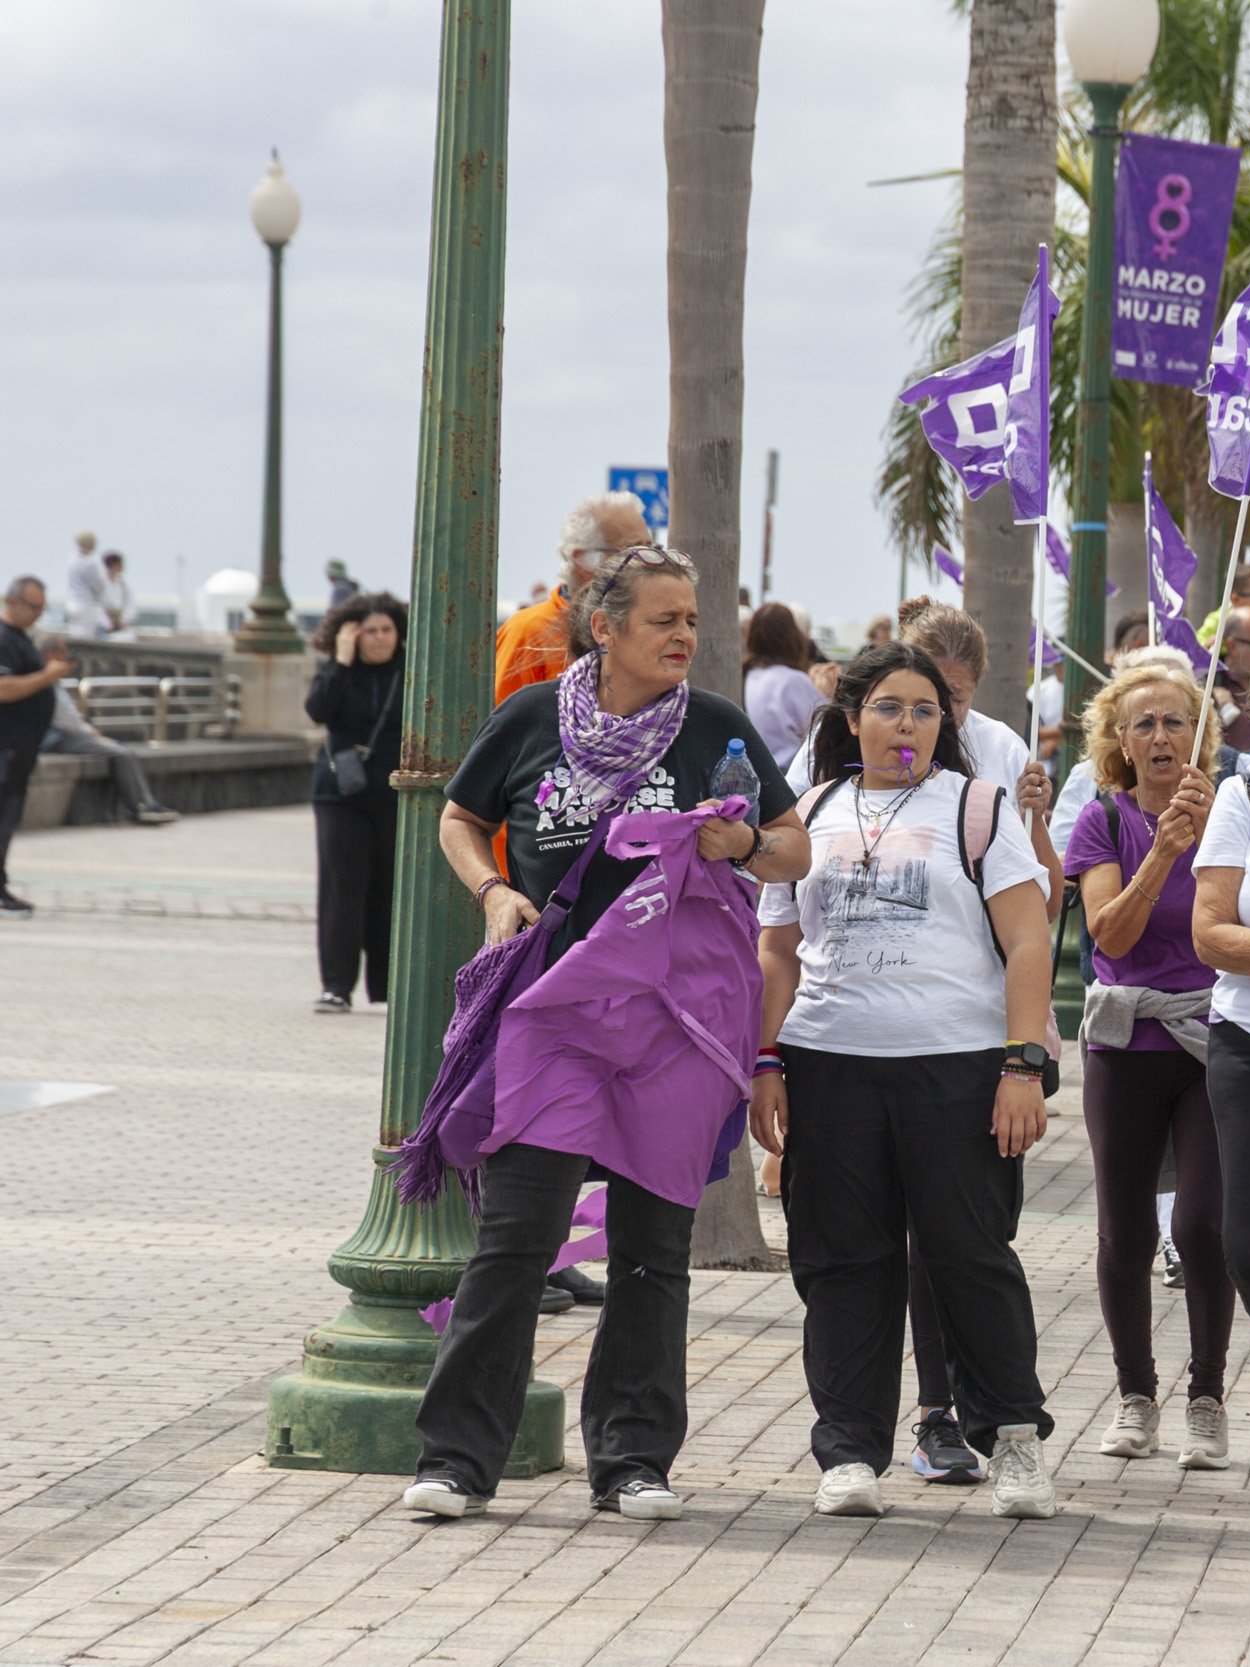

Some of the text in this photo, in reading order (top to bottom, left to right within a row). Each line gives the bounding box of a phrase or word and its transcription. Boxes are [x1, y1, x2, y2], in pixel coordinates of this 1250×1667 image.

[1118, 264, 1206, 296] MARZO
[1117, 298, 1201, 329] MUJER
[827, 951, 918, 975] New York
